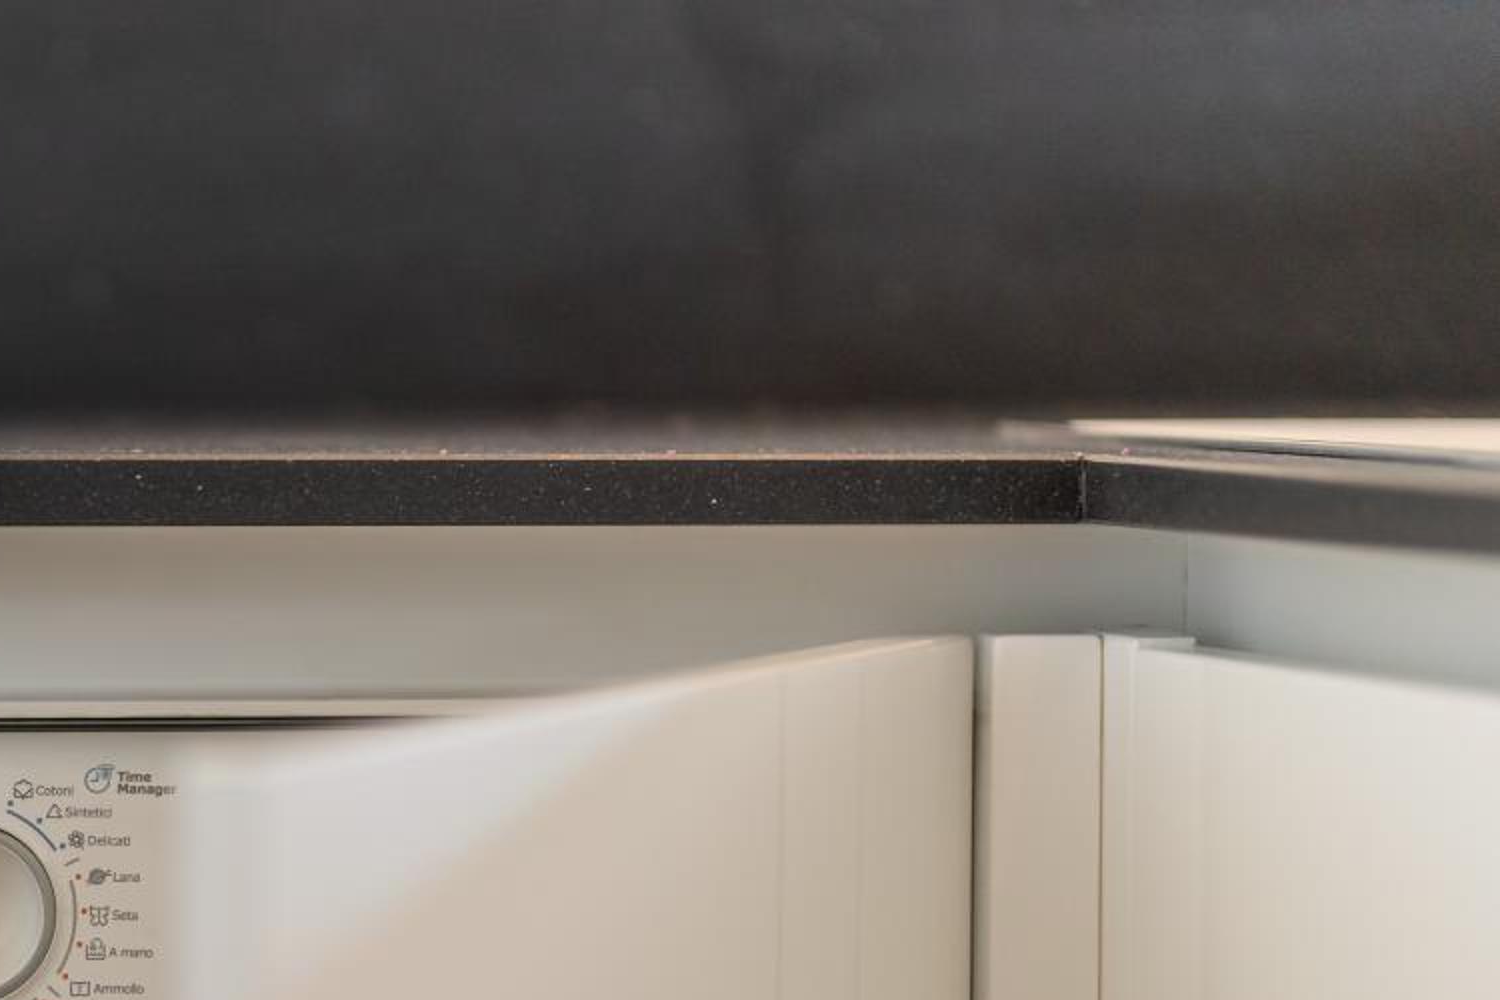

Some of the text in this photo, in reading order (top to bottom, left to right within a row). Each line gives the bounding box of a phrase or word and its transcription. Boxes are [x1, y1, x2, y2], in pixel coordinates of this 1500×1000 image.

[117, 771, 152, 783] Time
[35, 784, 74, 797] Cotoni
[65, 807, 112, 818] Sintetici
[87, 835, 131, 847] Delicati
[113, 872, 141, 883] Lana
[111, 909, 139, 921] Seta
[120, 949, 154, 958] mano
[93, 983, 144, 995] Ammollo
